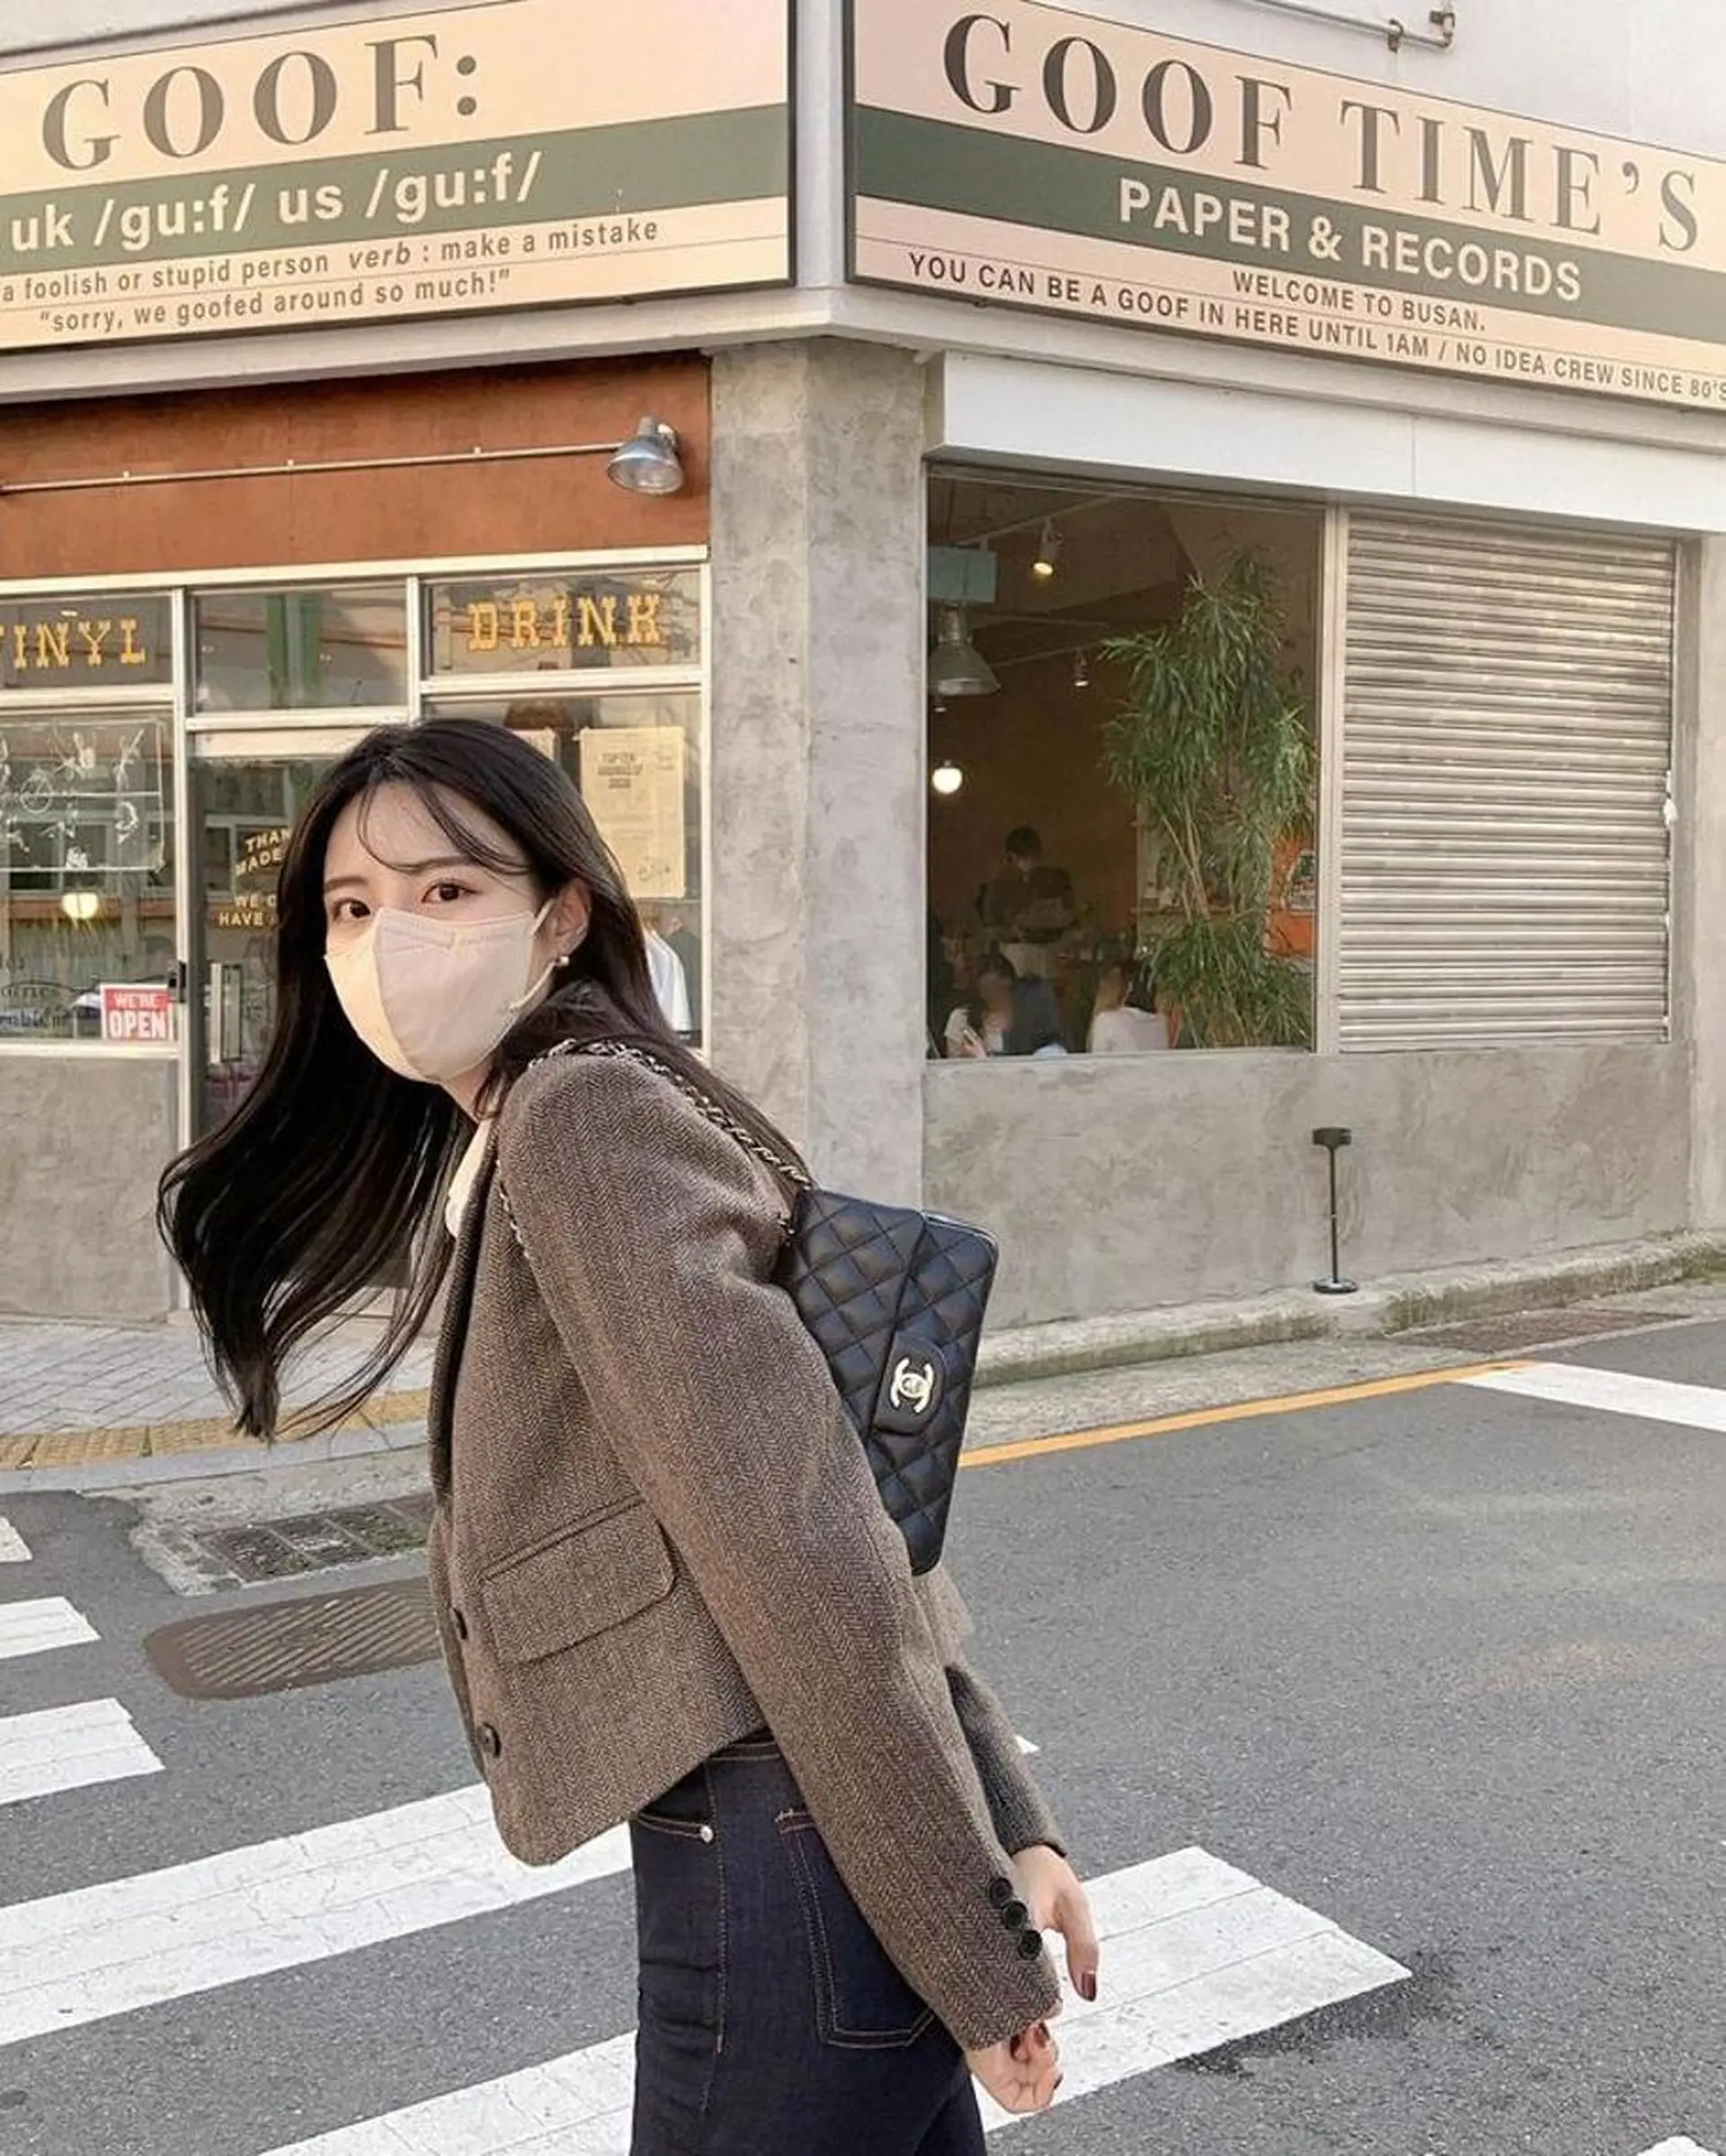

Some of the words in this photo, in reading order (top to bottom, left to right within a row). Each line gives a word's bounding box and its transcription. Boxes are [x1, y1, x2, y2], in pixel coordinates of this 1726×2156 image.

[42, 34, 477, 171] GOOF:
[944, 14, 1292, 170] GOOF
[1340, 100, 1698, 252] TIME'S
[11, 204, 74, 252] uk
[93, 183, 256, 252] /gu:f/
[280, 185, 343, 224] us
[365, 151, 541, 224] /gu:f/
[3, 285, 14, 301] a
[25, 272, 107, 299] foolish
[119, 273, 140, 290] or
[153, 259, 230, 288] stupid
[242, 254, 328, 284] person
[350, 242, 411, 270] verb
[441, 233, 511, 261] make
[522, 234, 535, 253] a
[547, 217, 658, 251] mistake
[1120, 178, 1291, 252] PAPER
[1308, 216, 1342, 262] &
[1362, 225, 1581, 302] RECORDS
[40, 310, 123, 333] "sorry,
[135, 305, 165, 324] we
[177, 293, 262, 326] goofed
[274, 283, 363, 313] around
[376, 285, 403, 304] so
[416, 268, 510, 299] much!"
[909, 252, 965, 283] YOU
[979, 265, 1034, 295] CAN
[1048, 276, 1080, 302] BE
[1091, 284, 1107, 306] A
[1117, 288, 1188, 318] GOOF
[1200, 302, 1223, 325] IN
[1235, 307, 1299, 337] HERE
[1309, 318, 1377, 350] UNTIL
[1387, 333, 1428, 357] 1AM
[1456, 342, 1486, 365] NO
[1495, 349, 1546, 375] IDEA
[1553, 358, 1614, 384] CREW
[1621, 368, 1683, 395] SINCE
[1690, 378, 1726, 401] 80'S
[1233, 271, 1355, 311] WELCOME
[1365, 293, 1392, 315] TO
[1402, 301, 1485, 332] BUSAN.
[0, 617, 147, 669] INYL
[467, 593, 660, 652] DRINK
[245, 828, 292, 852] THAN
[218, 911, 263, 927] HAVE
[109, 1009, 166, 1039] OPEN
